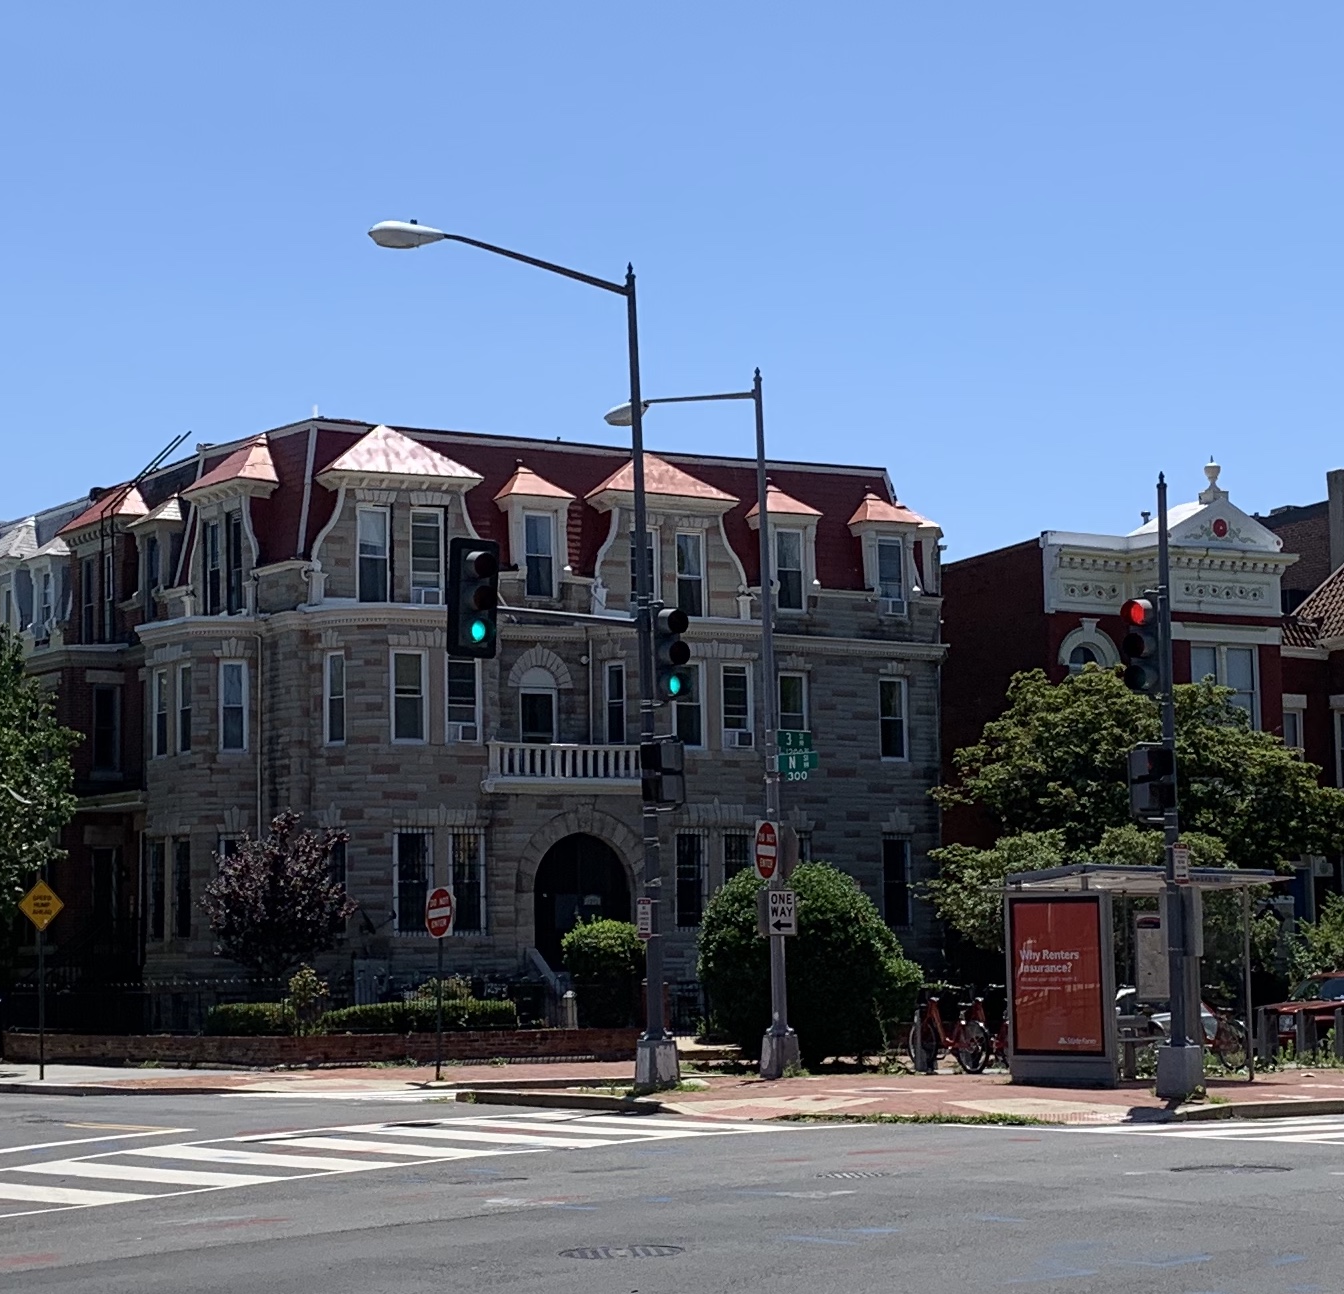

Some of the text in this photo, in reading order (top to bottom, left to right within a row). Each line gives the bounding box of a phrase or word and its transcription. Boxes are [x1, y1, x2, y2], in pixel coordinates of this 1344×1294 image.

[786, 732, 792, 746] 3
[789, 756, 796, 769] N
[787, 771, 808, 781] 300
[770, 893, 793, 905] ONE
[770, 906, 793, 917] WAY
[1020, 949, 1080, 962] Why Renters
[1020, 961, 1073, 973] Insurance?
